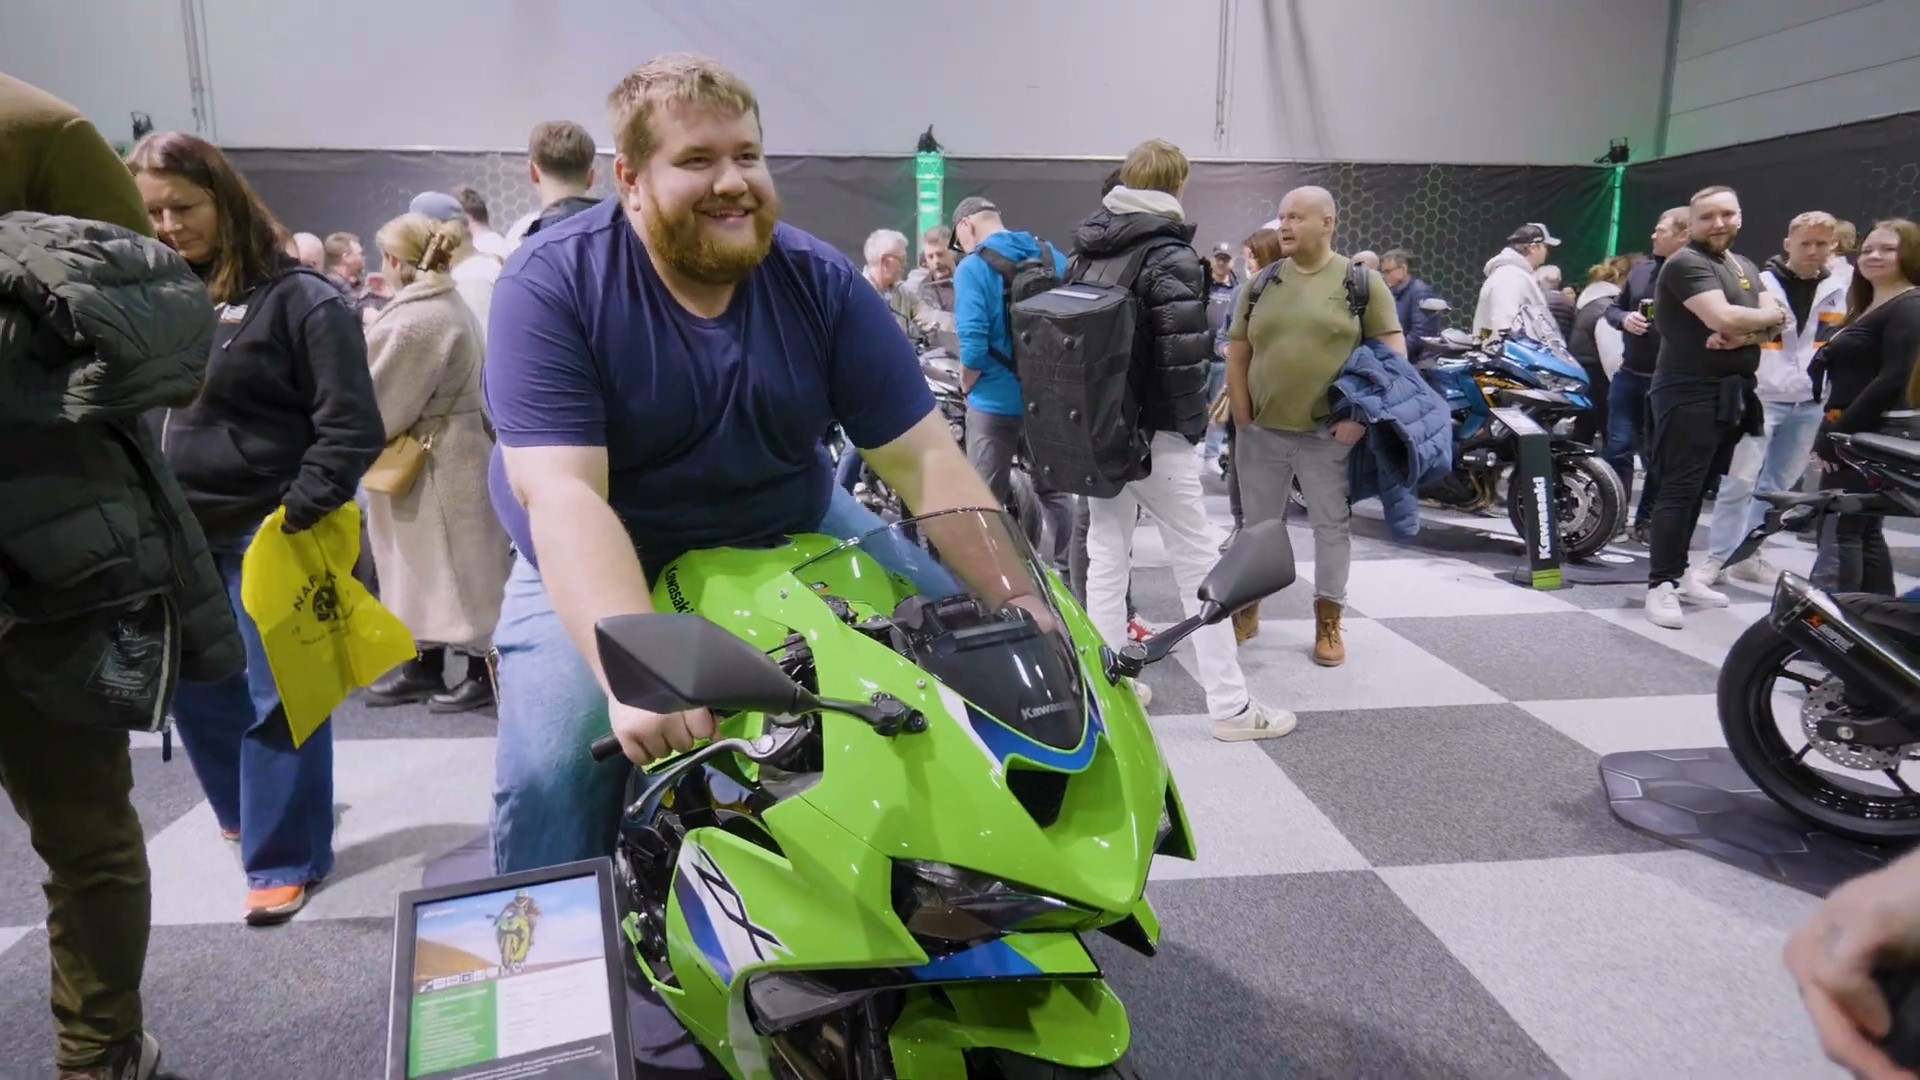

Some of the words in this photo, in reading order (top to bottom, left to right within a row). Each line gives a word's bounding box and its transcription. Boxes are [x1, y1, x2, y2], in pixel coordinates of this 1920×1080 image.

[1533, 477, 1551, 560] Kawasaki
[1021, 701, 1072, 721] Kawas
[691, 845, 783, 962] ZX
